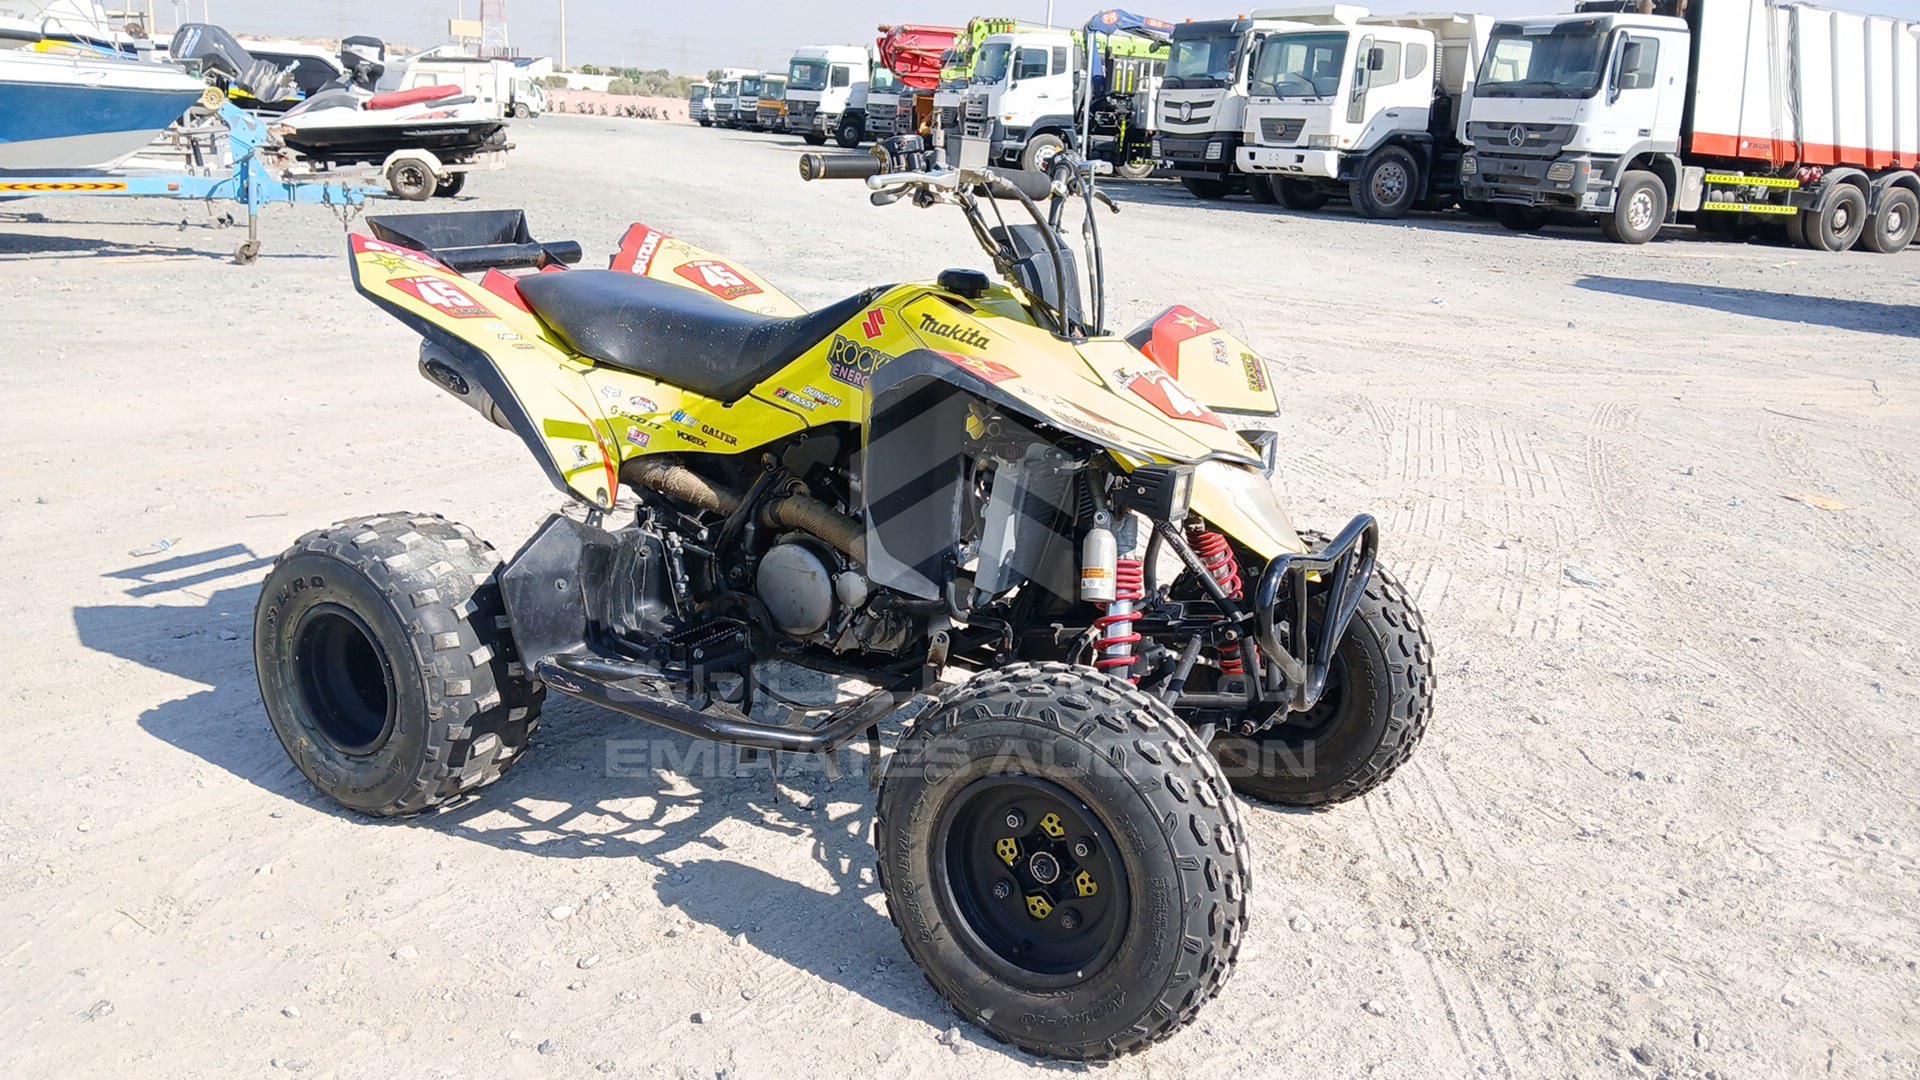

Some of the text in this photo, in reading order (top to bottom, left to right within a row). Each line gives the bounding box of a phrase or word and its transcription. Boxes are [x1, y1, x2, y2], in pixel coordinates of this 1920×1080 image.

[632, 230, 662, 275] SUZUKI
[699, 265, 745, 288] 45
[415, 280, 476, 309] 45
[802, 385, 841, 408] DUNCAN
[676, 430, 708, 448] VORTEX
[701, 424, 738, 446] GALFER
